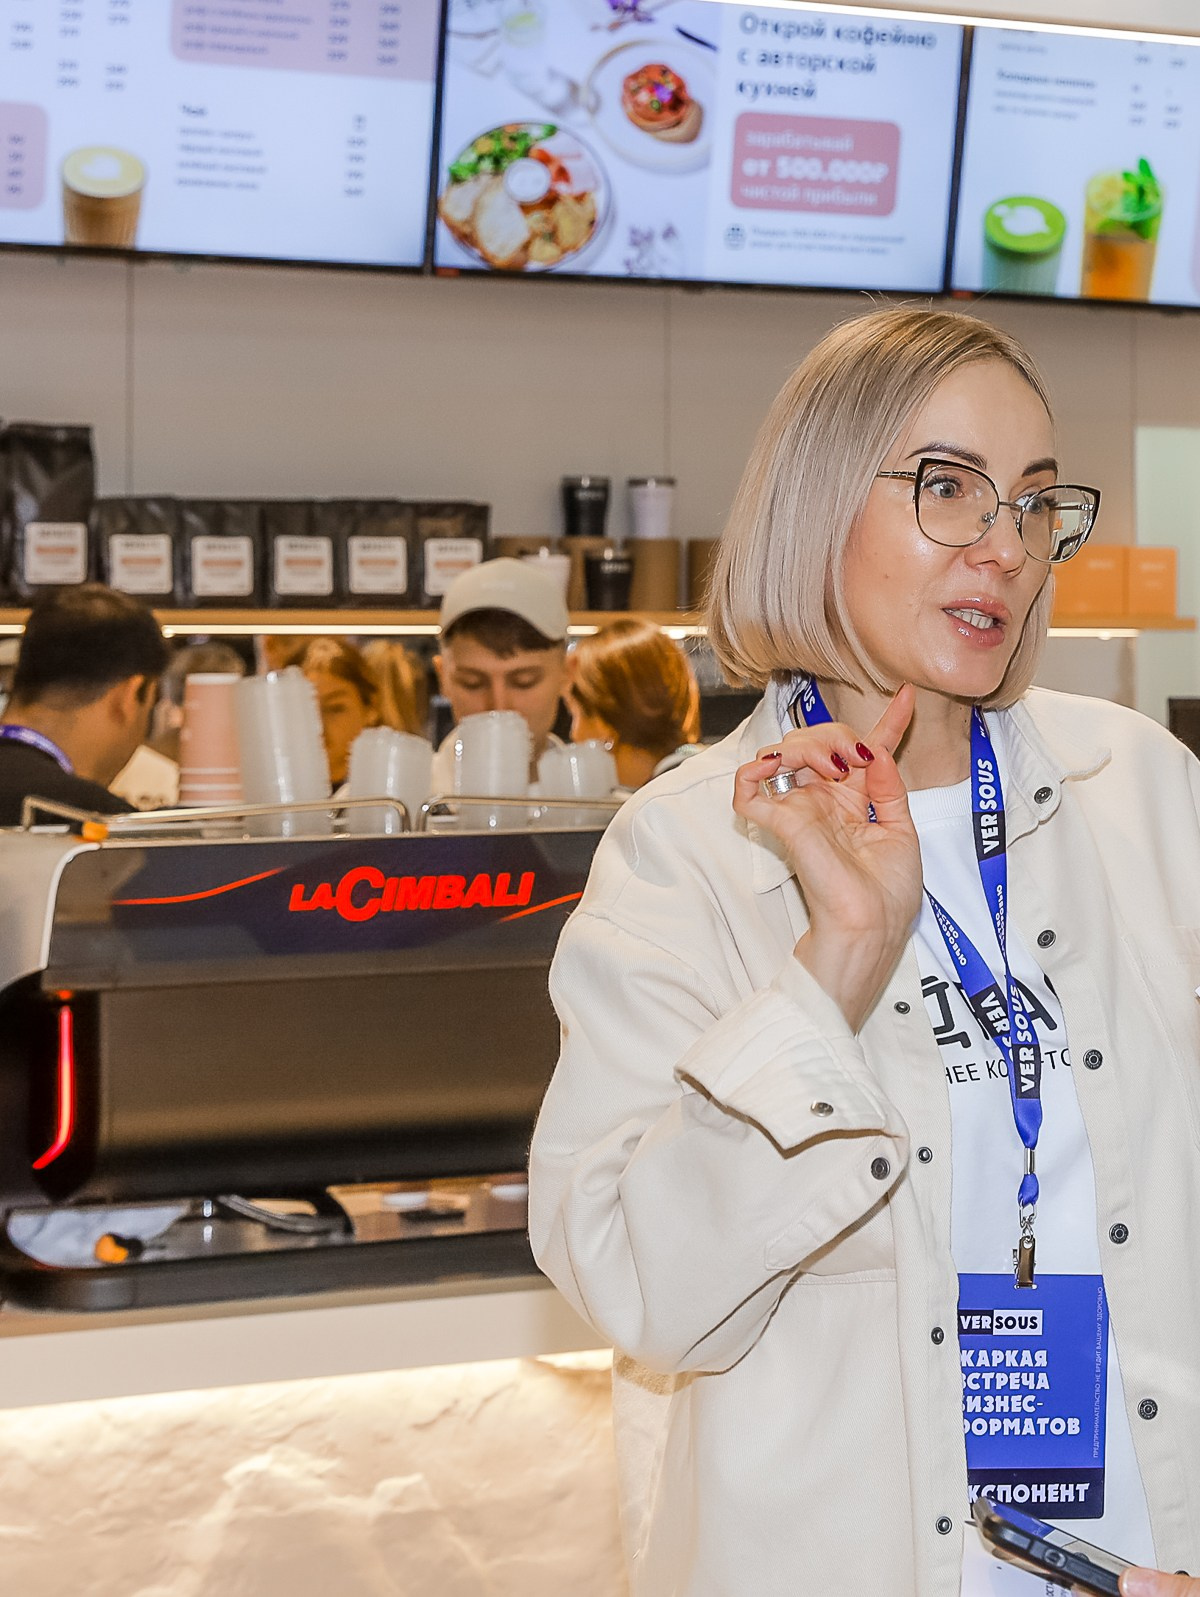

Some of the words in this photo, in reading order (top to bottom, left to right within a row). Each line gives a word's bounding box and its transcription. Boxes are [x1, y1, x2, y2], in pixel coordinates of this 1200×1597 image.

[740, 12, 825, 42] Открой
[833, 25, 937, 48] кофейню
[737, 49, 748, 65] с
[757, 53, 876, 72] авторской
[737, 80, 816, 101] кухней
[742, 158, 771, 177] от
[962, 1395, 1044, 1413] ИЗНЕС-
[1093, 1384, 1101, 1458] ПРЕДПРИНИМАТЕЛЬСТВО
[968, 1483, 1090, 1504] КСПОНЕНТ
